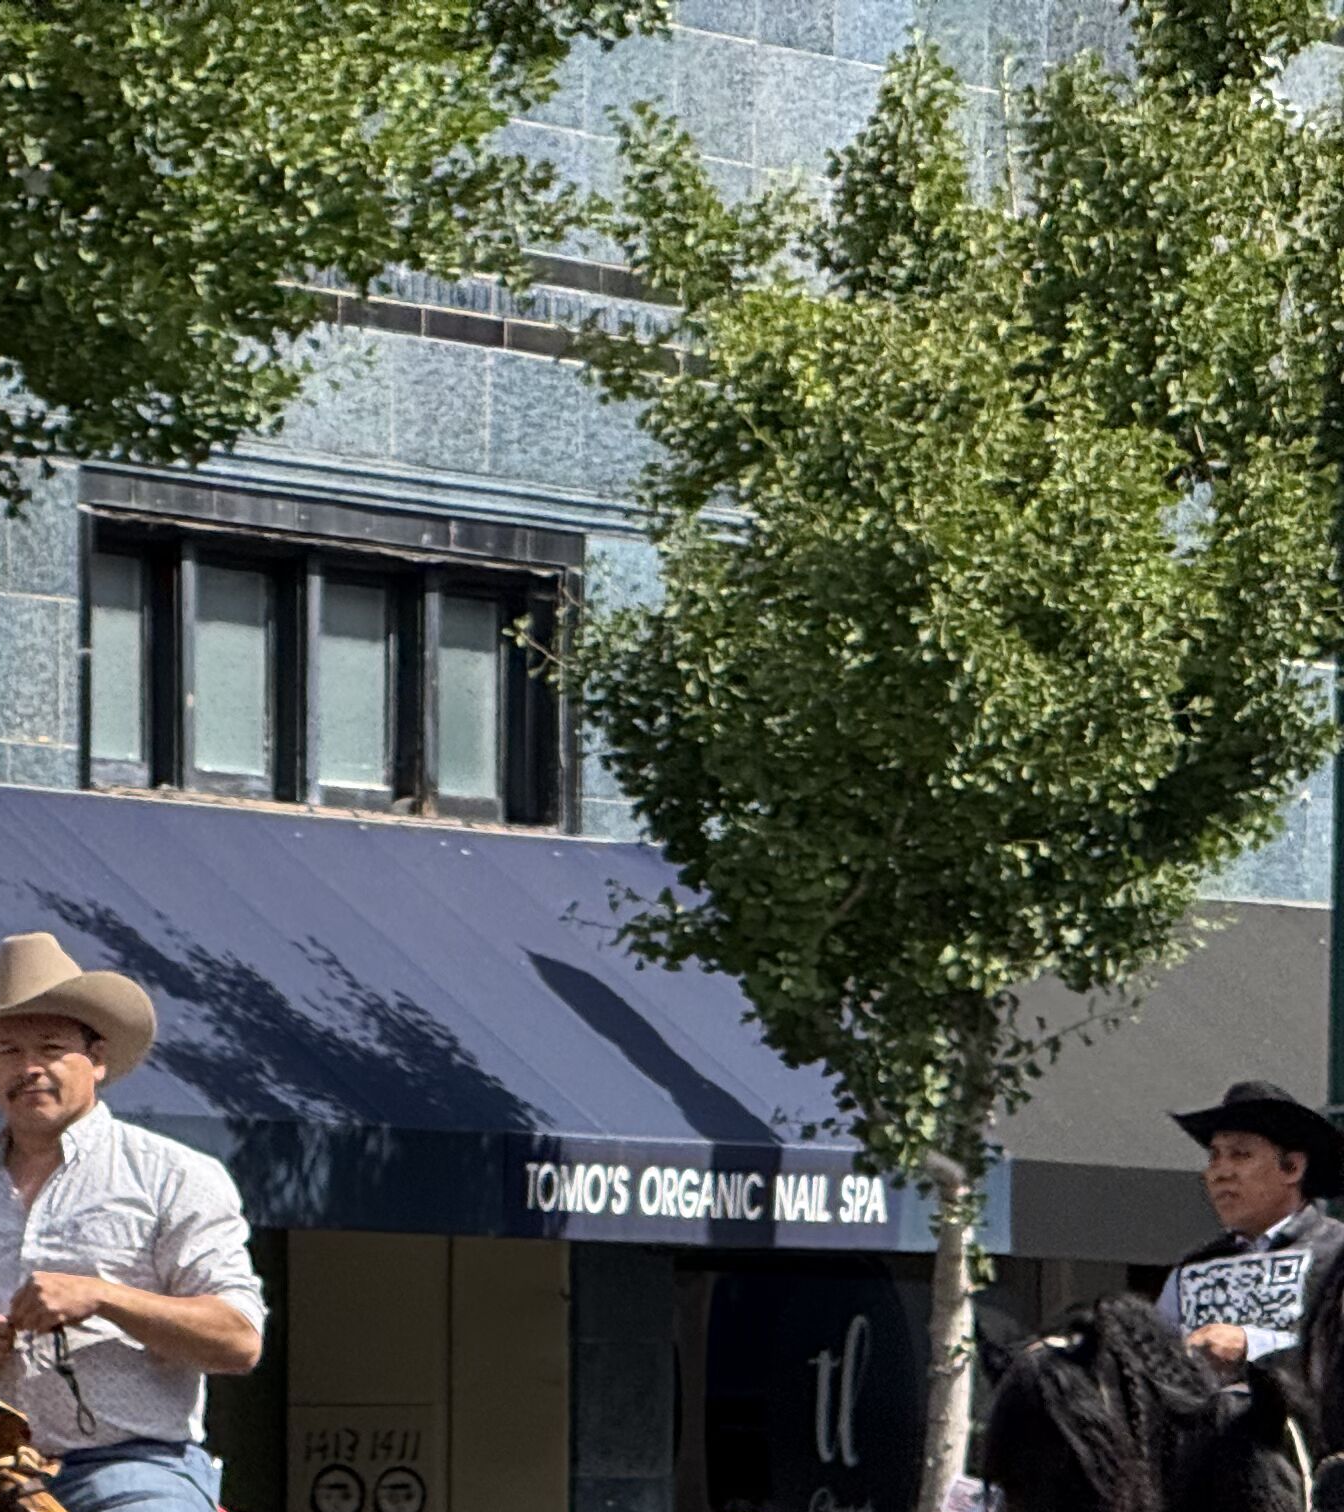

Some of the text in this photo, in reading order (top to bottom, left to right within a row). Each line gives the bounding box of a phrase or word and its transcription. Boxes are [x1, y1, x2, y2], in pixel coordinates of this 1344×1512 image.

[525, 1161, 888, 1224] TOMO'S ORGANIC NAIL SPA
